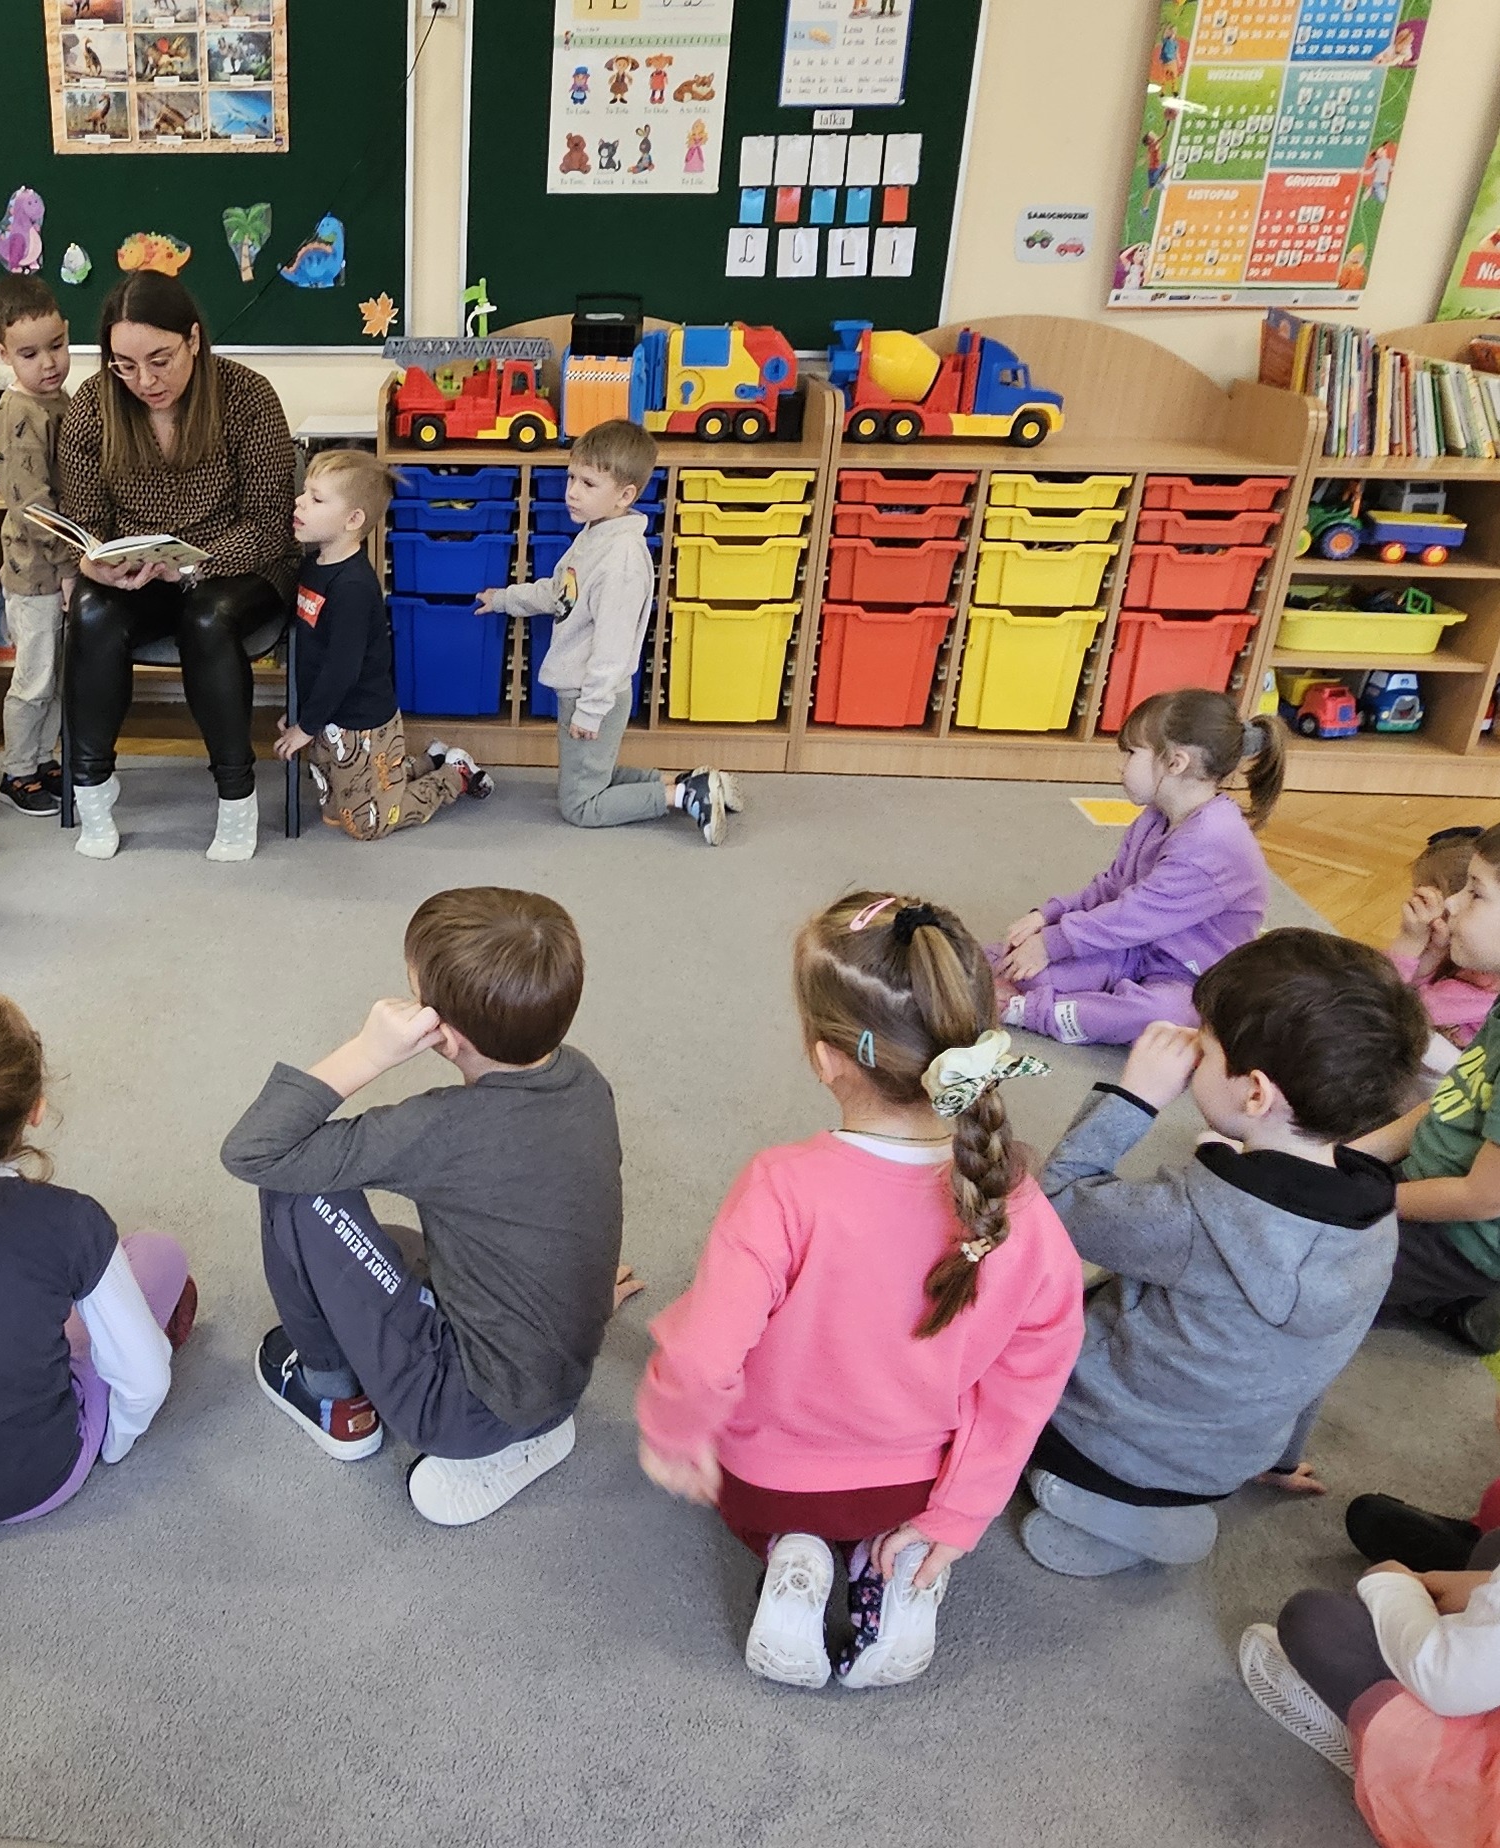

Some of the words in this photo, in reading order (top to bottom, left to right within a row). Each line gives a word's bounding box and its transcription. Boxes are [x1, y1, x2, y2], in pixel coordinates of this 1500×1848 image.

[1187, 189, 1239, 200] LISTOPAD
[840, 239, 855, 265] L
[312, 1195, 338, 1225] FUN
[334, 1220, 369, 1261] BEING
[365, 1257, 398, 1294] ENJOY
